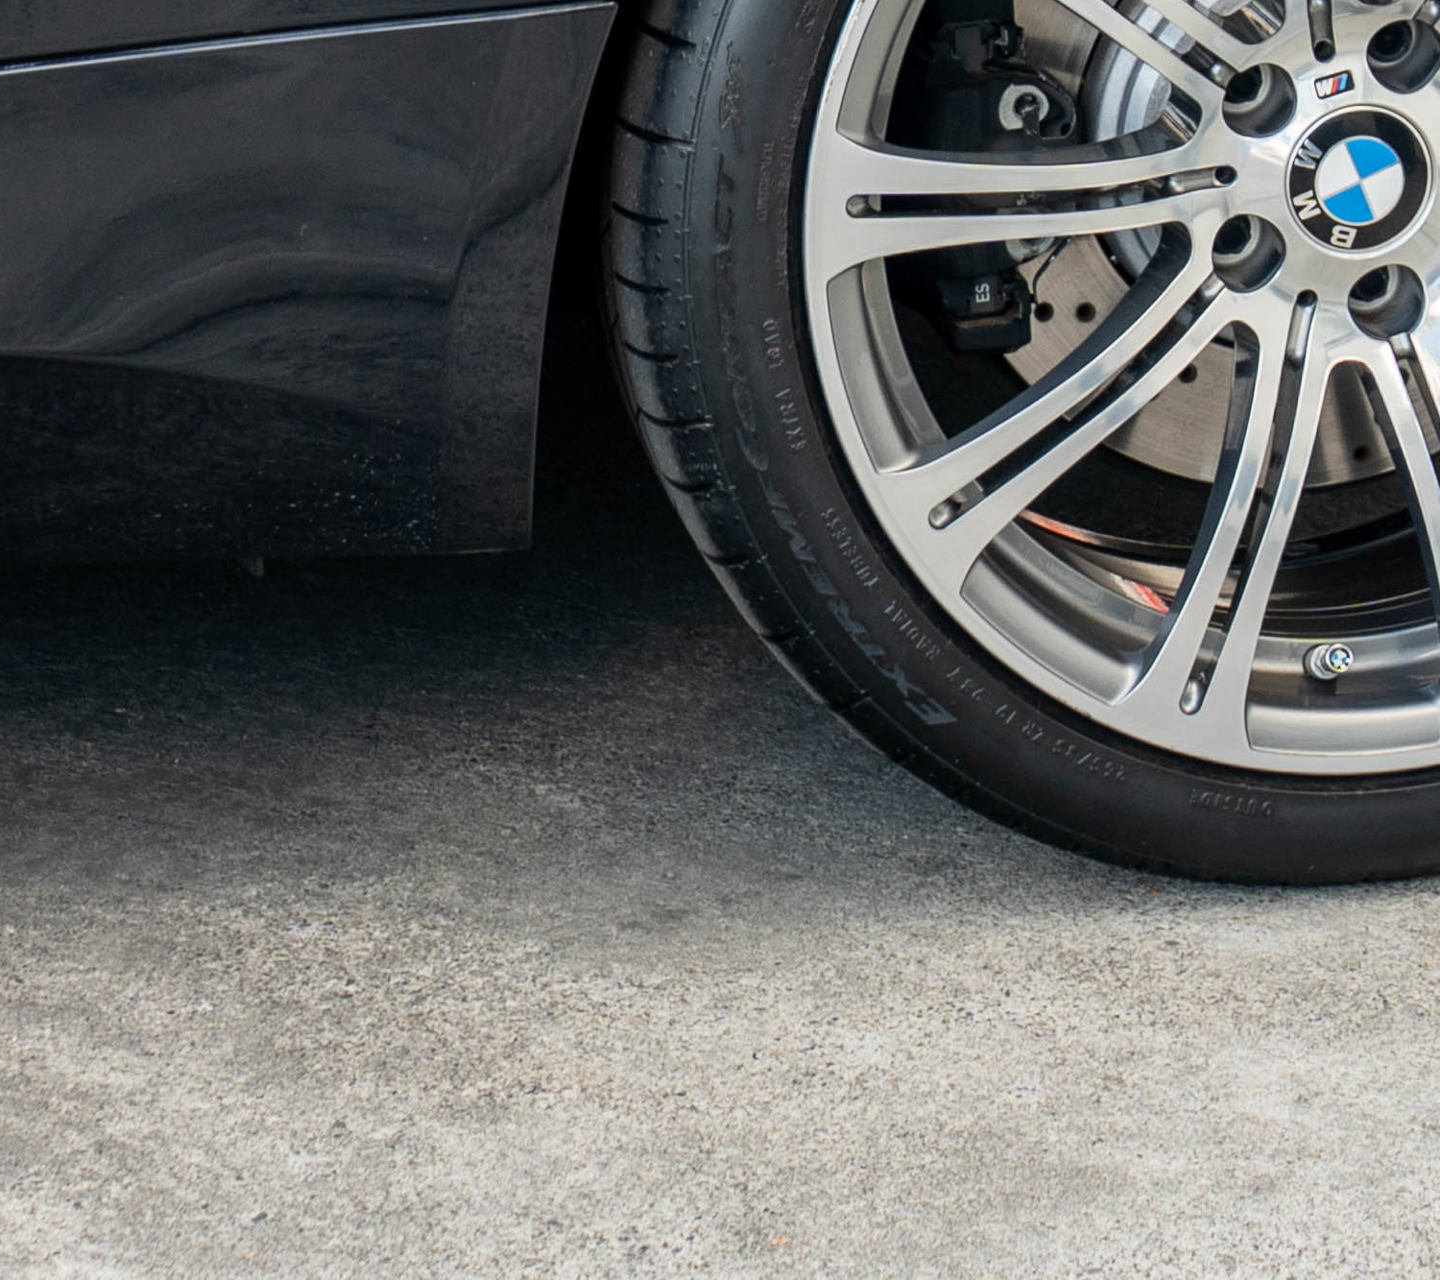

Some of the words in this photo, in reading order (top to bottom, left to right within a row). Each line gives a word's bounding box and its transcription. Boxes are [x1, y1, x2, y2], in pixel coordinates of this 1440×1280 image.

[1292, 138, 1357, 249] BMW
[975, 282, 991, 304] ES
[773, 386, 808, 452] EXTRA
